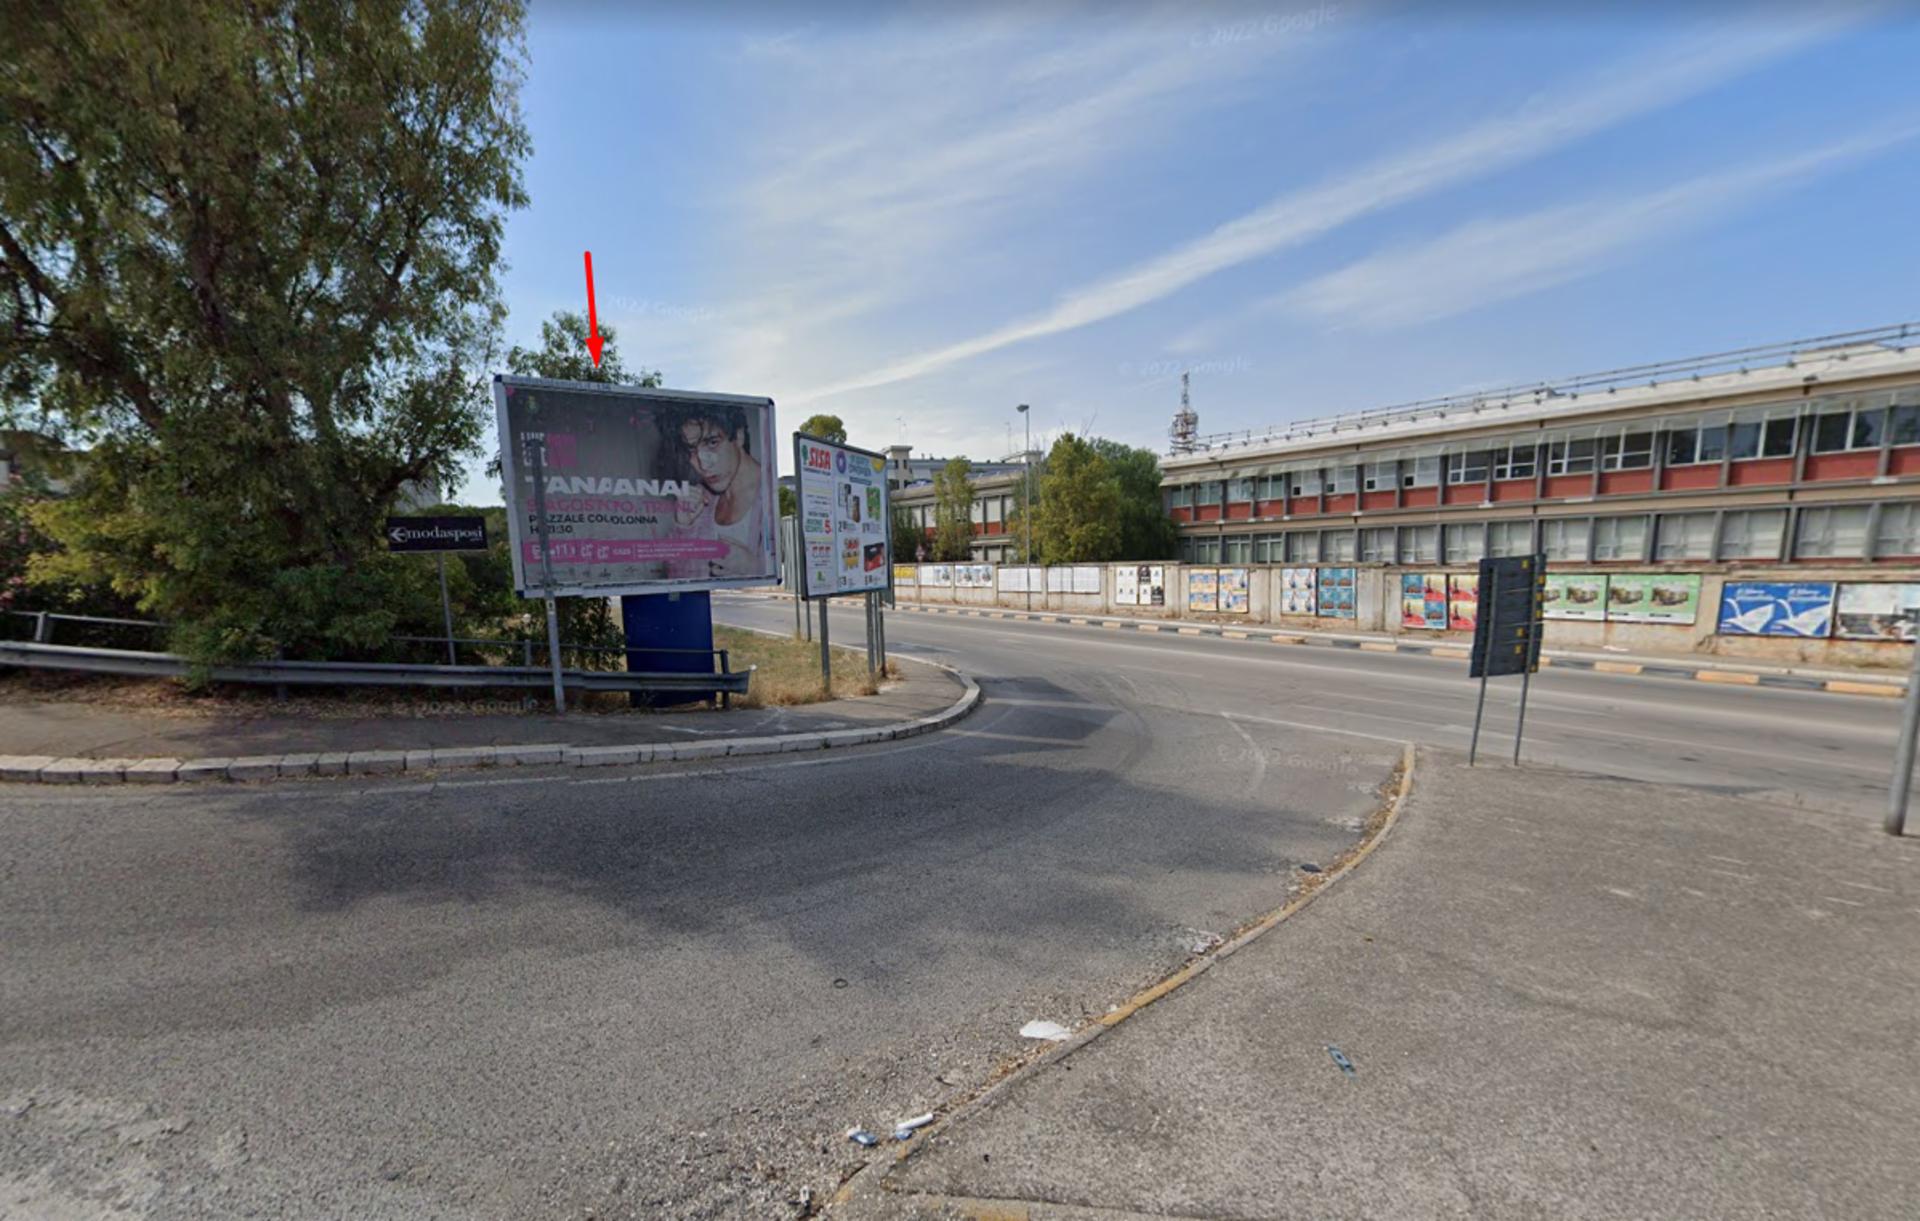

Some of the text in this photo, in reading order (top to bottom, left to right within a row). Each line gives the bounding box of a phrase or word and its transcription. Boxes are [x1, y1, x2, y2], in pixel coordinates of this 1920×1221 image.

[808, 447, 832, 470] SISA
[529, 514, 585, 523] PZZALE
[407, 526, 483, 542] modasposi
